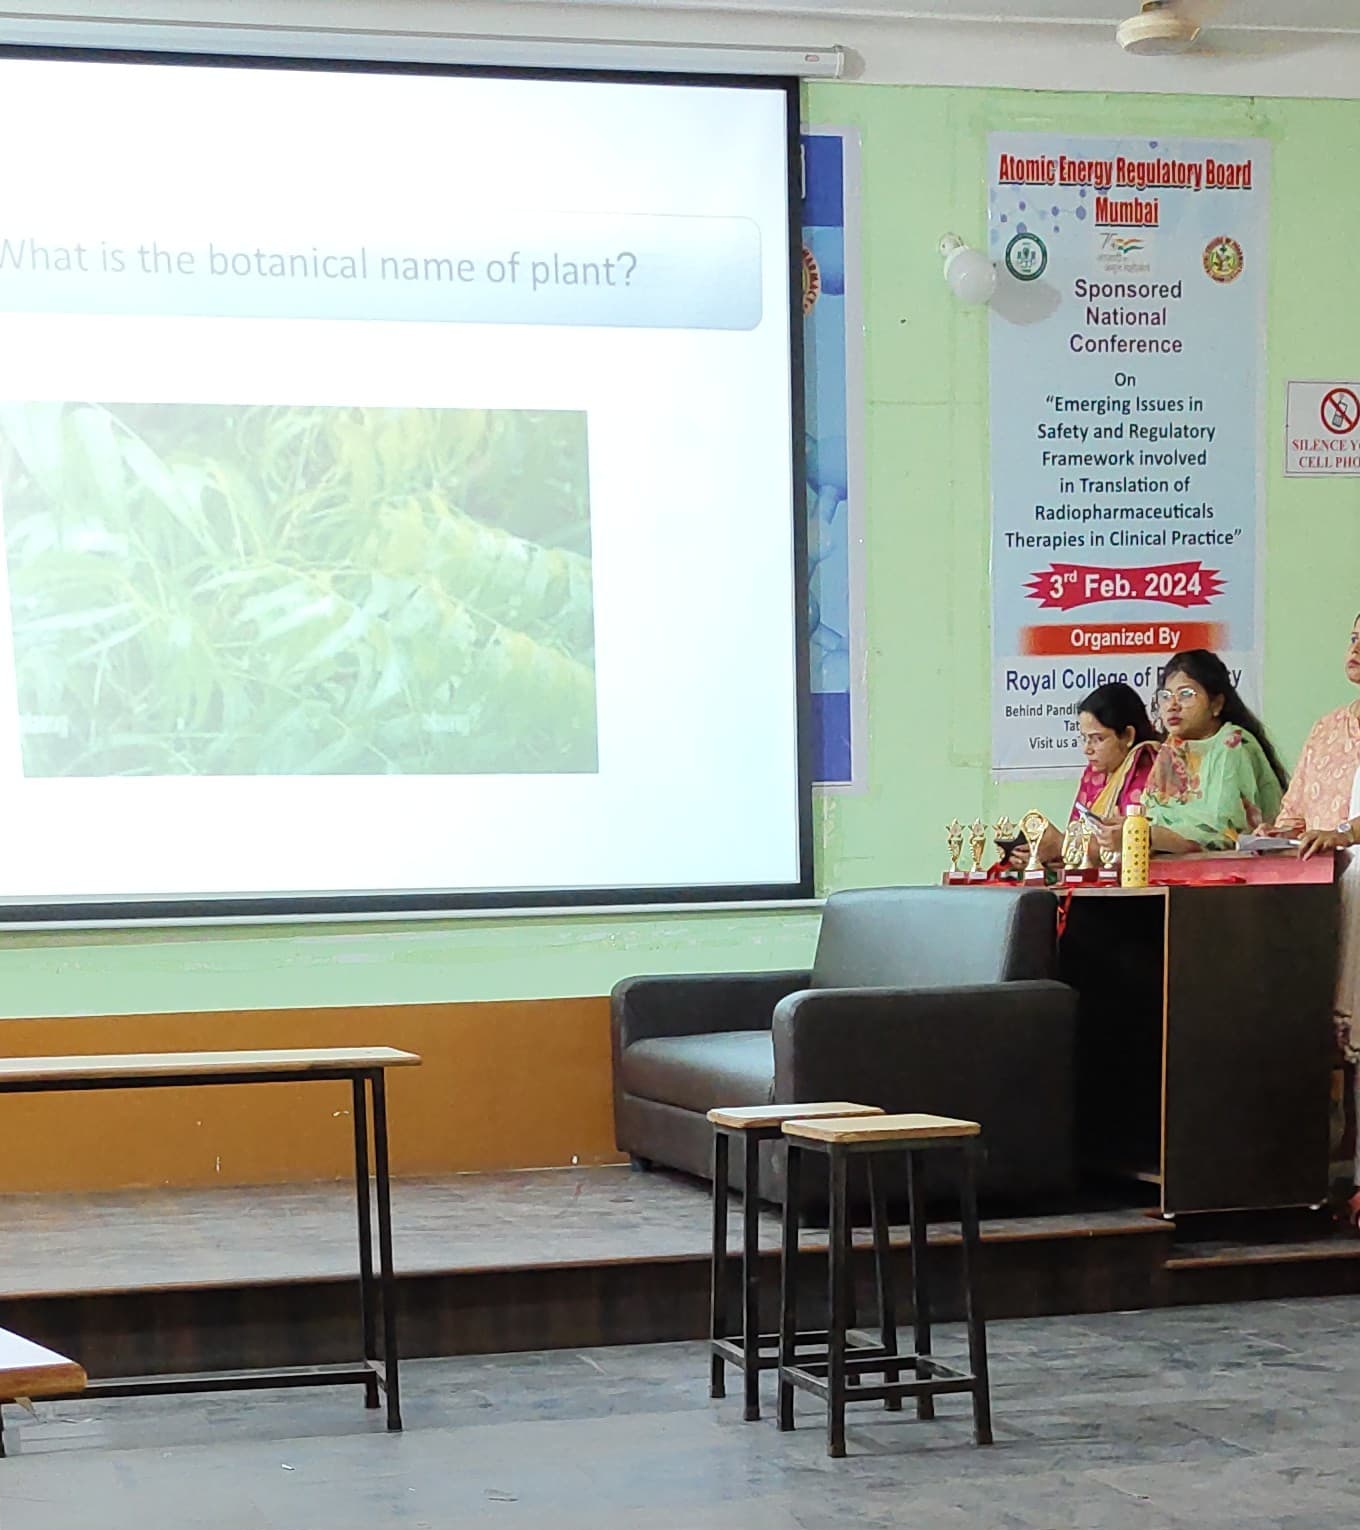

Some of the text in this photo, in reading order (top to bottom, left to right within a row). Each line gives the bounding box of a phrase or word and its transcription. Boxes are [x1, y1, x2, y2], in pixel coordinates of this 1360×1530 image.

[999, 153, 1252, 192] Atomic Energy Regulatory Board
[1095, 196, 1160, 228] Mumbai
[101, 240, 126, 273] is
[137, 240, 197, 276] the
[209, 241, 368, 281] botanical
[380, 256, 477, 284] name
[485, 250, 522, 285] of
[531, 250, 640, 293] plant?
[1074, 278, 1183, 301] Sponsored
[1085, 307, 1167, 327] National
[1069, 334, 1183, 354] Conference
[1114, 372, 1136, 388] On
[1135, 396, 1184, 413] Issues
[1188, 397, 1204, 413] in
[1037, 423, 1216, 444] Safety and Regulatory
[1292, 439, 1346, 452] SILENCE
[1041, 450, 1207, 467] Framework involved
[1298, 455, 1334, 469] CELL
[1059, 476, 1191, 494] in Translation of
[1035, 503, 1215, 524] Radiopharmaceuticals
[1005, 531, 1086, 551] Therapies
[1090, 531, 1106, 547] in
[1109, 530, 1167, 547] Clinical
[1049, 569, 1203, 599] 3rd Feb. 2024
[1070, 627, 1181, 650] Organized By
[1006, 668, 1056, 696] Royal
[1133, 666, 1152, 687] of
[1005, 703, 1080, 718] Behind Pandi
[1029, 737, 1054, 749] Visit
[1056, 738, 1069, 748] us
